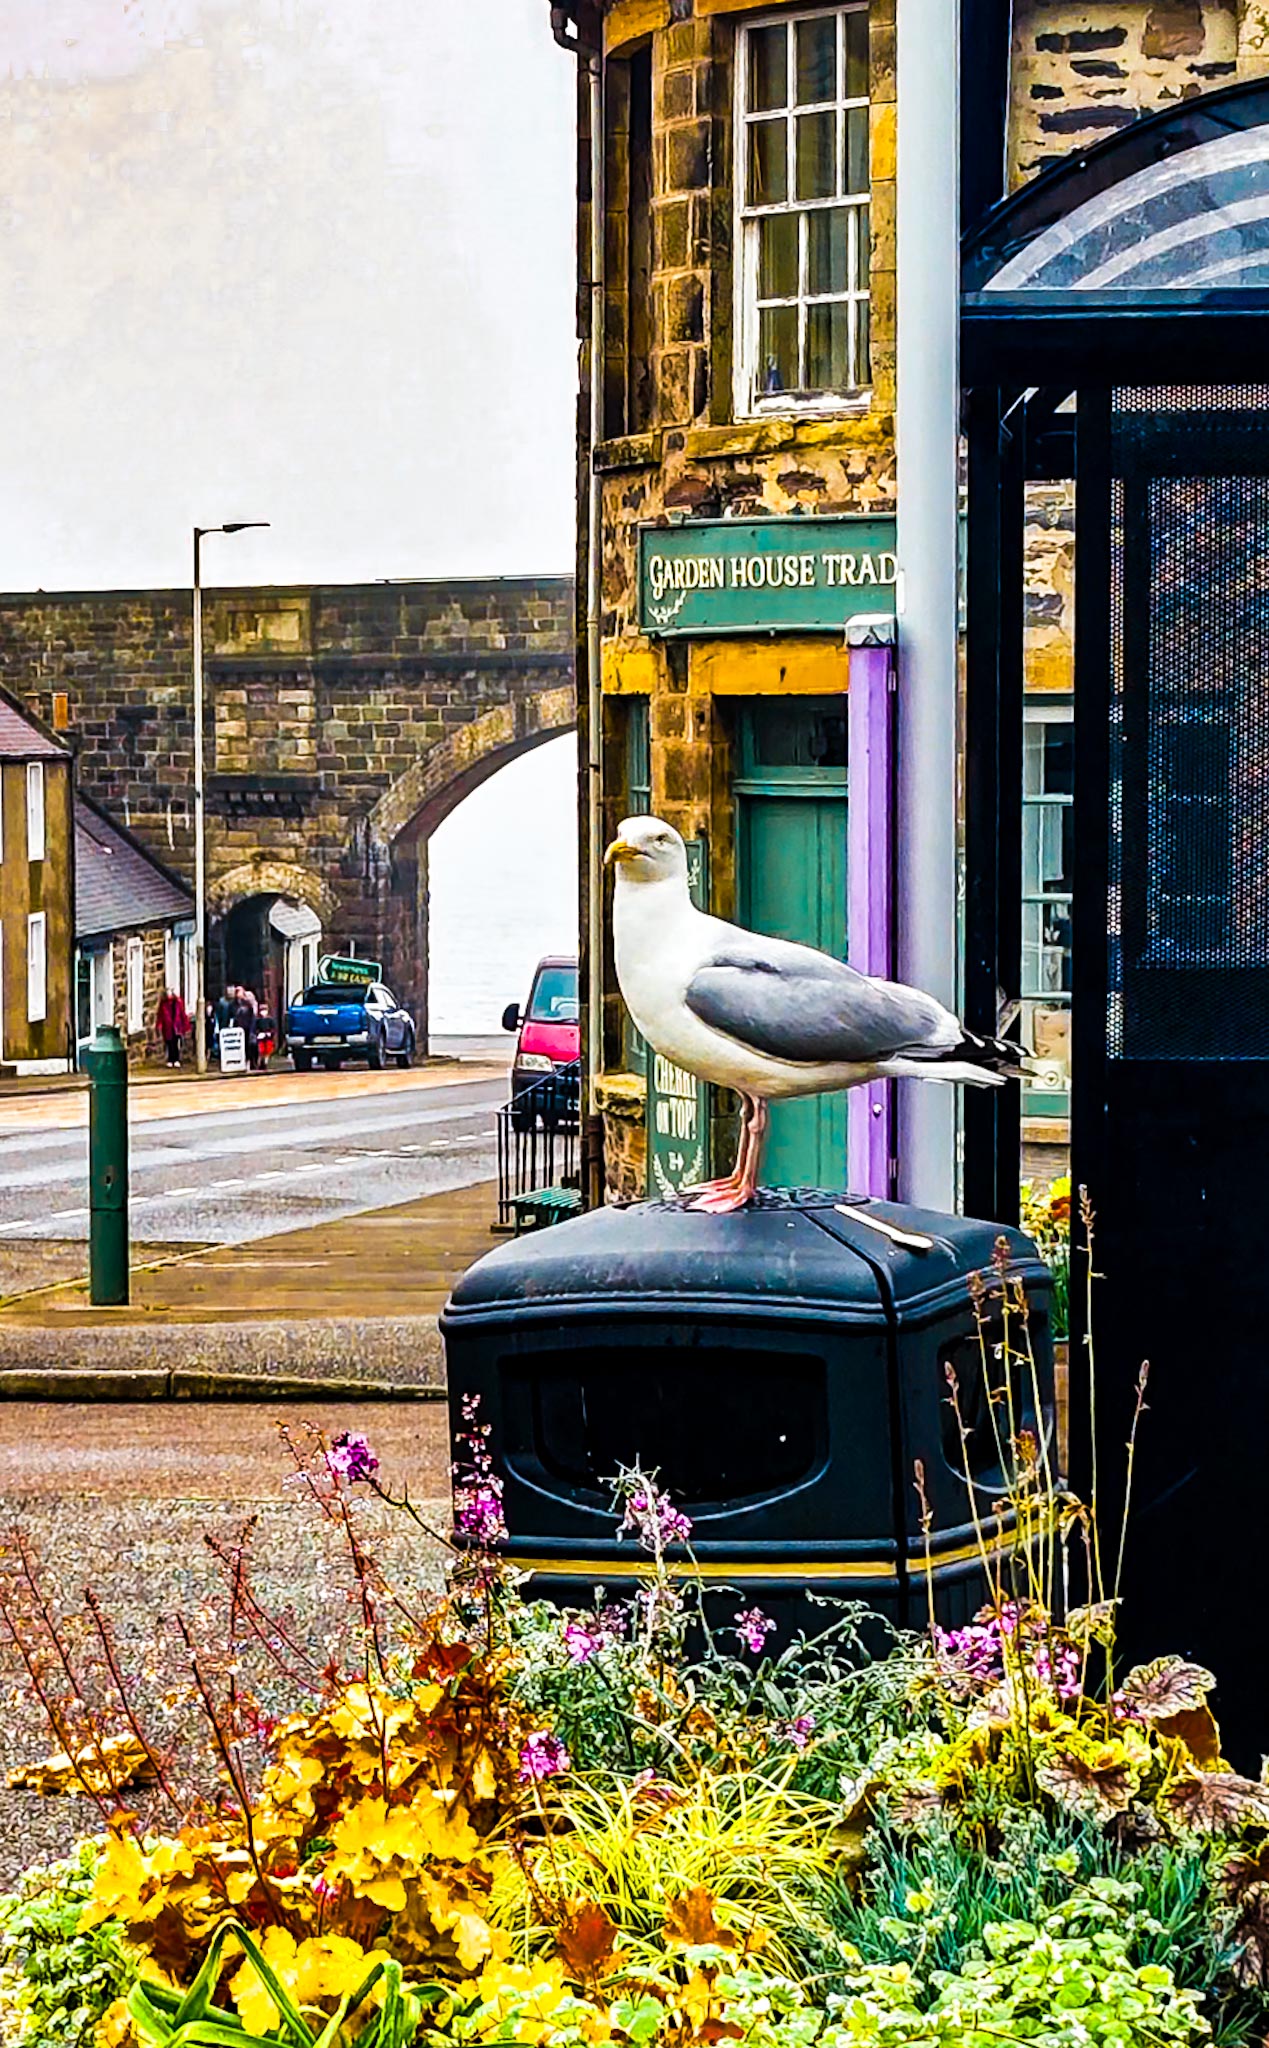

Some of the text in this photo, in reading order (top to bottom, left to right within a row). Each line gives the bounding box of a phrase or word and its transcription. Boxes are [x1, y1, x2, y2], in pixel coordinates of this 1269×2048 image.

[650, 555, 724, 600] GARDEN
[730, 554, 816, 588] HOUSE
[656, 1096, 697, 1140] ON TOP!
